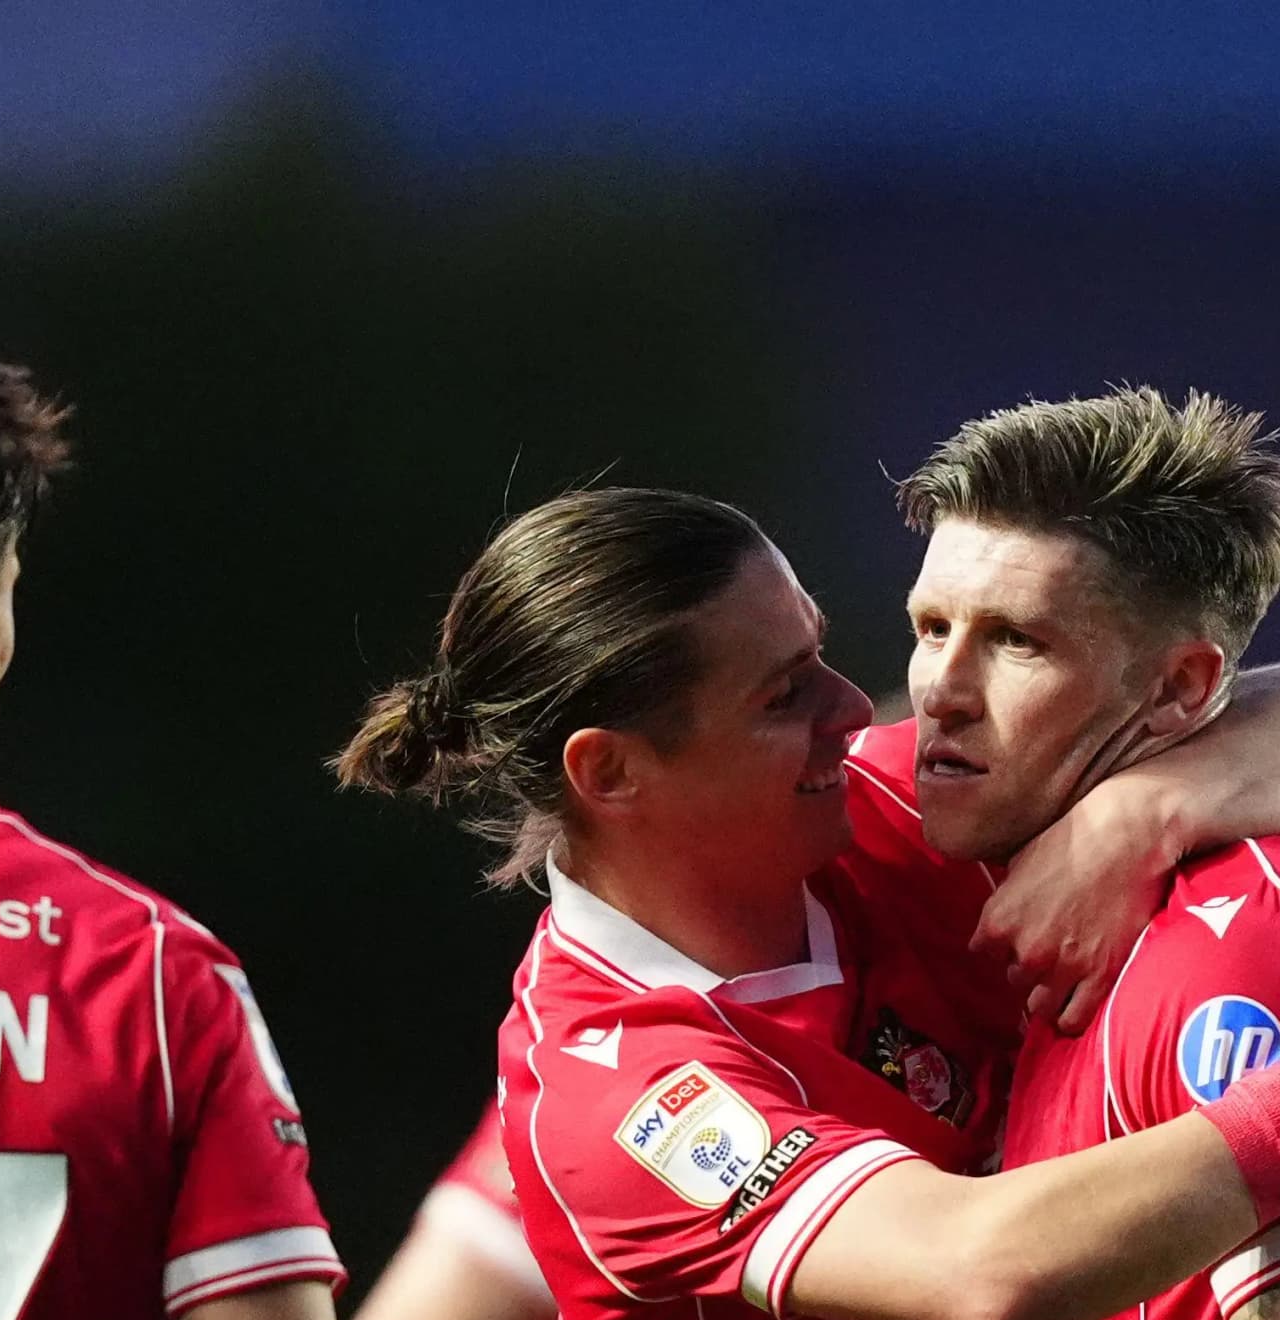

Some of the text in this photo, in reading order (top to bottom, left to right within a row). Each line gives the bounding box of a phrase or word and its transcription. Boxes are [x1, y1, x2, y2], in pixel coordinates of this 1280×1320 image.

[633, 1076, 705, 1147] sky bet
[718, 1156, 750, 1187] EFL
[720, 1129, 816, 1233] GETHER
